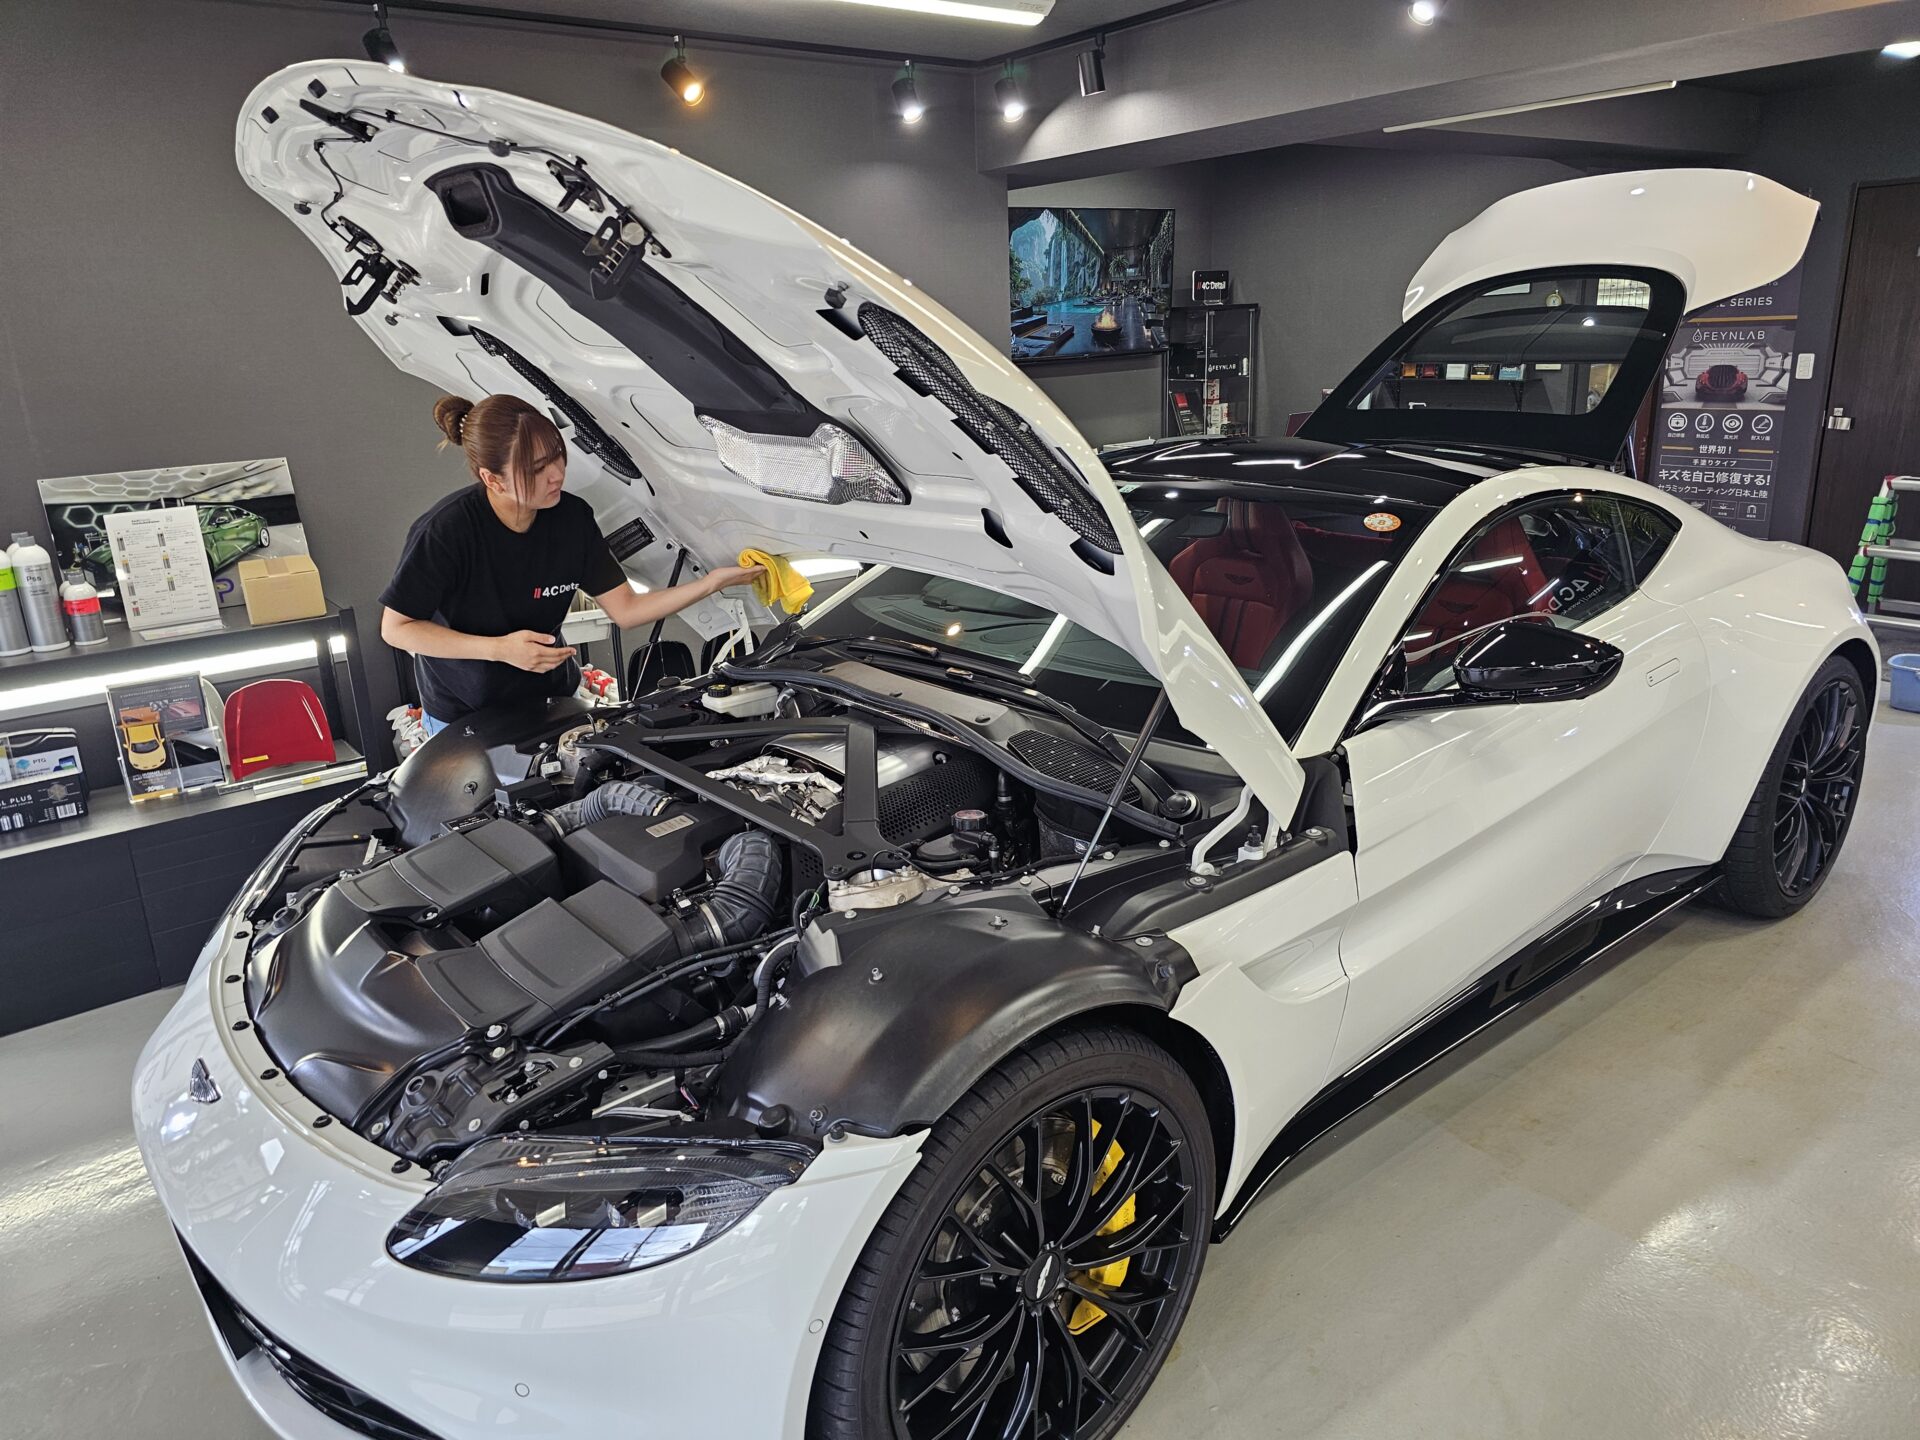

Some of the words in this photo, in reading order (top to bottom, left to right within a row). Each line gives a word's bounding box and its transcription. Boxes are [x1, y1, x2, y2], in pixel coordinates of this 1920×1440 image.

[1730, 297, 1773, 307] SERIES
[1703, 330, 1765, 341] FEYNLAB
[1657, 484, 1768, 499] セラミックコーティング日本上陸
[10, 794, 33, 804] PLUS
